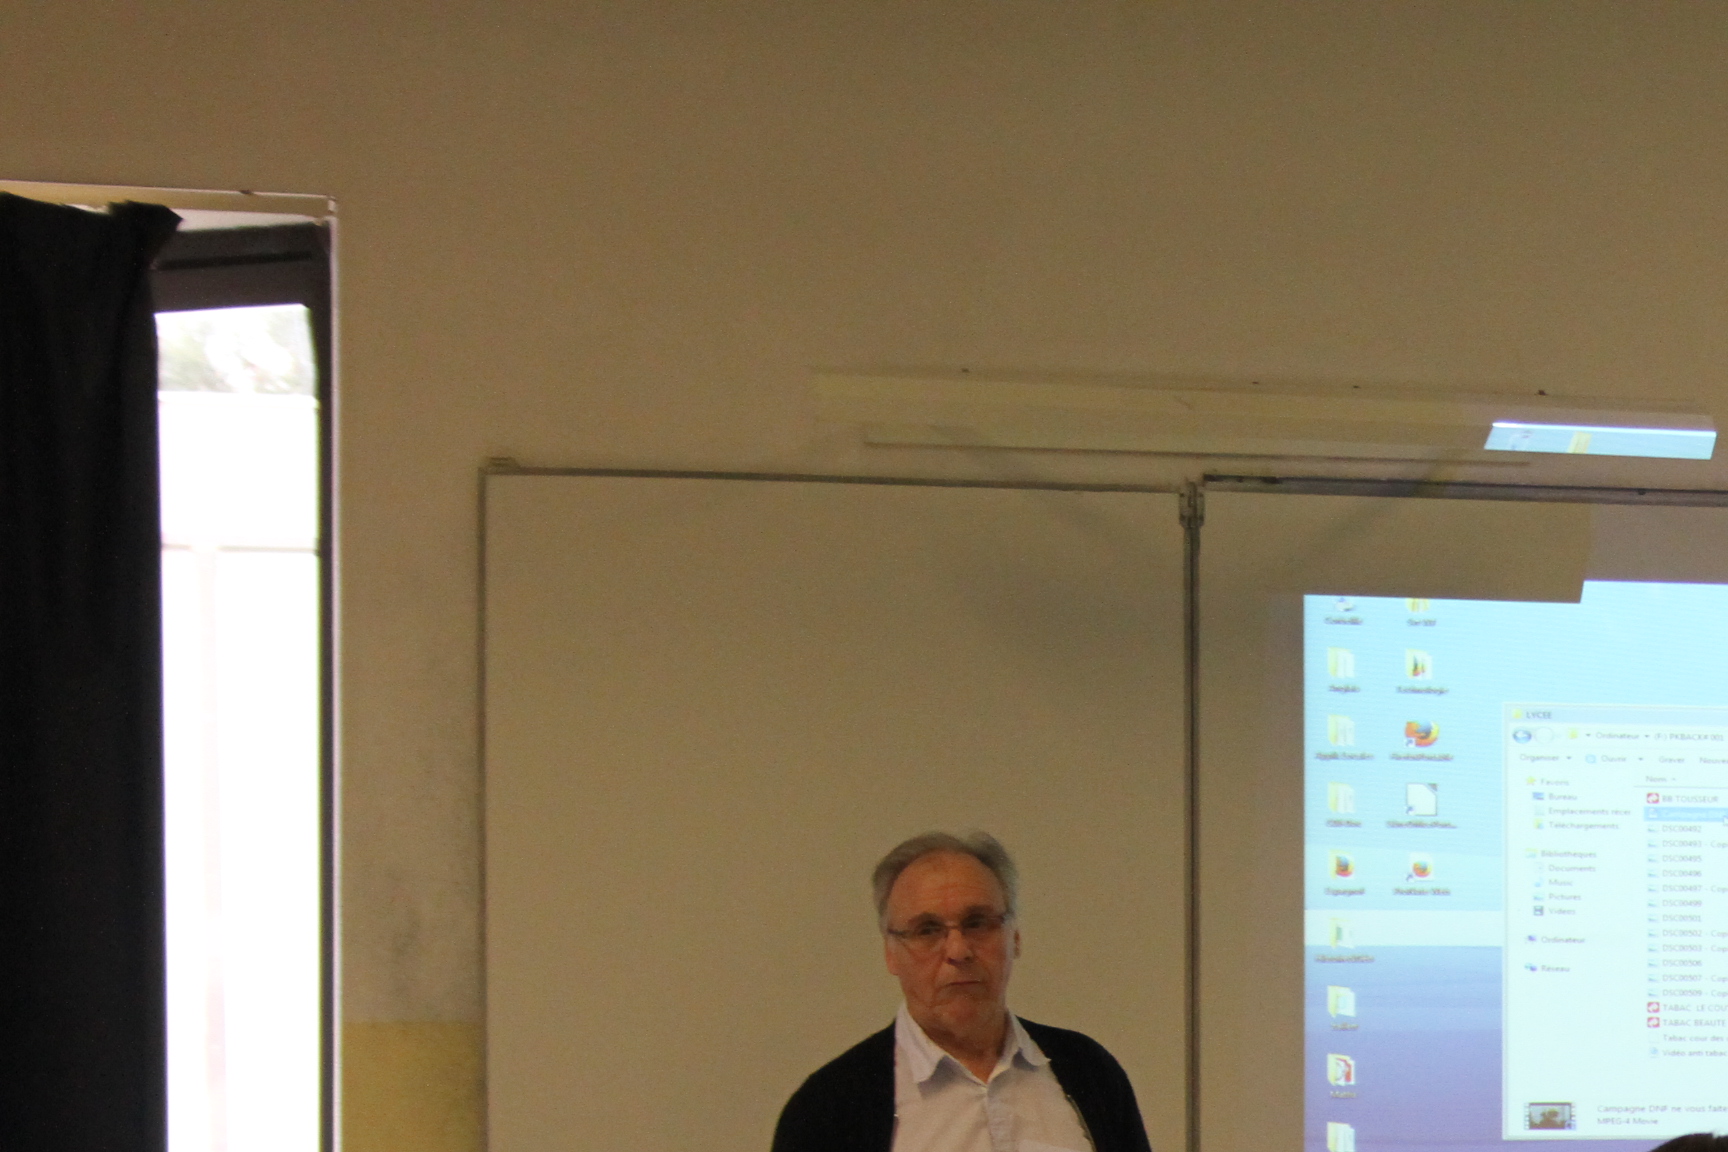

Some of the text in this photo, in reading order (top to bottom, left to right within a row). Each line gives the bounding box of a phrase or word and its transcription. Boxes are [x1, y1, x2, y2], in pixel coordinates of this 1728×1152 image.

[1526, 710, 1552, 719] LYCEE
[1596, 731, 1640, 740] Ordinateur
[1519, 752, 1560, 763] Organiser
[1600, 754, 1627, 763] Ouvrir
[1658, 755, 1686, 764] Graver
[1645, 774, 1667, 783] Nom
[1548, 792, 1578, 801] Bureau
[1675, 795, 1719, 803] TOUSSEUR
[1548, 806, 1607, 817] Emplacements
[1548, 863, 1596, 872] Documents
[1548, 878, 1573, 887] Music
[1548, 892, 1582, 901] Pictures
[1541, 935, 1586, 943] Ordinateur
[1662, 1003, 1692, 1012] TABAC
[1696, 1003, 1705, 1012] LE
[1662, 1018, 1692, 1028] TABAC
[1663, 1033, 1687, 1042] Tabac
[1689, 1034, 1708, 1043] cour
[1710, 1034, 1724, 1043] des
[1705, 1049, 1728, 1058] tabac
[1597, 1104, 1646, 1115] Campagne
[1671, 1105, 1682, 1113] ne
[1685, 1105, 1706, 1113] vous
